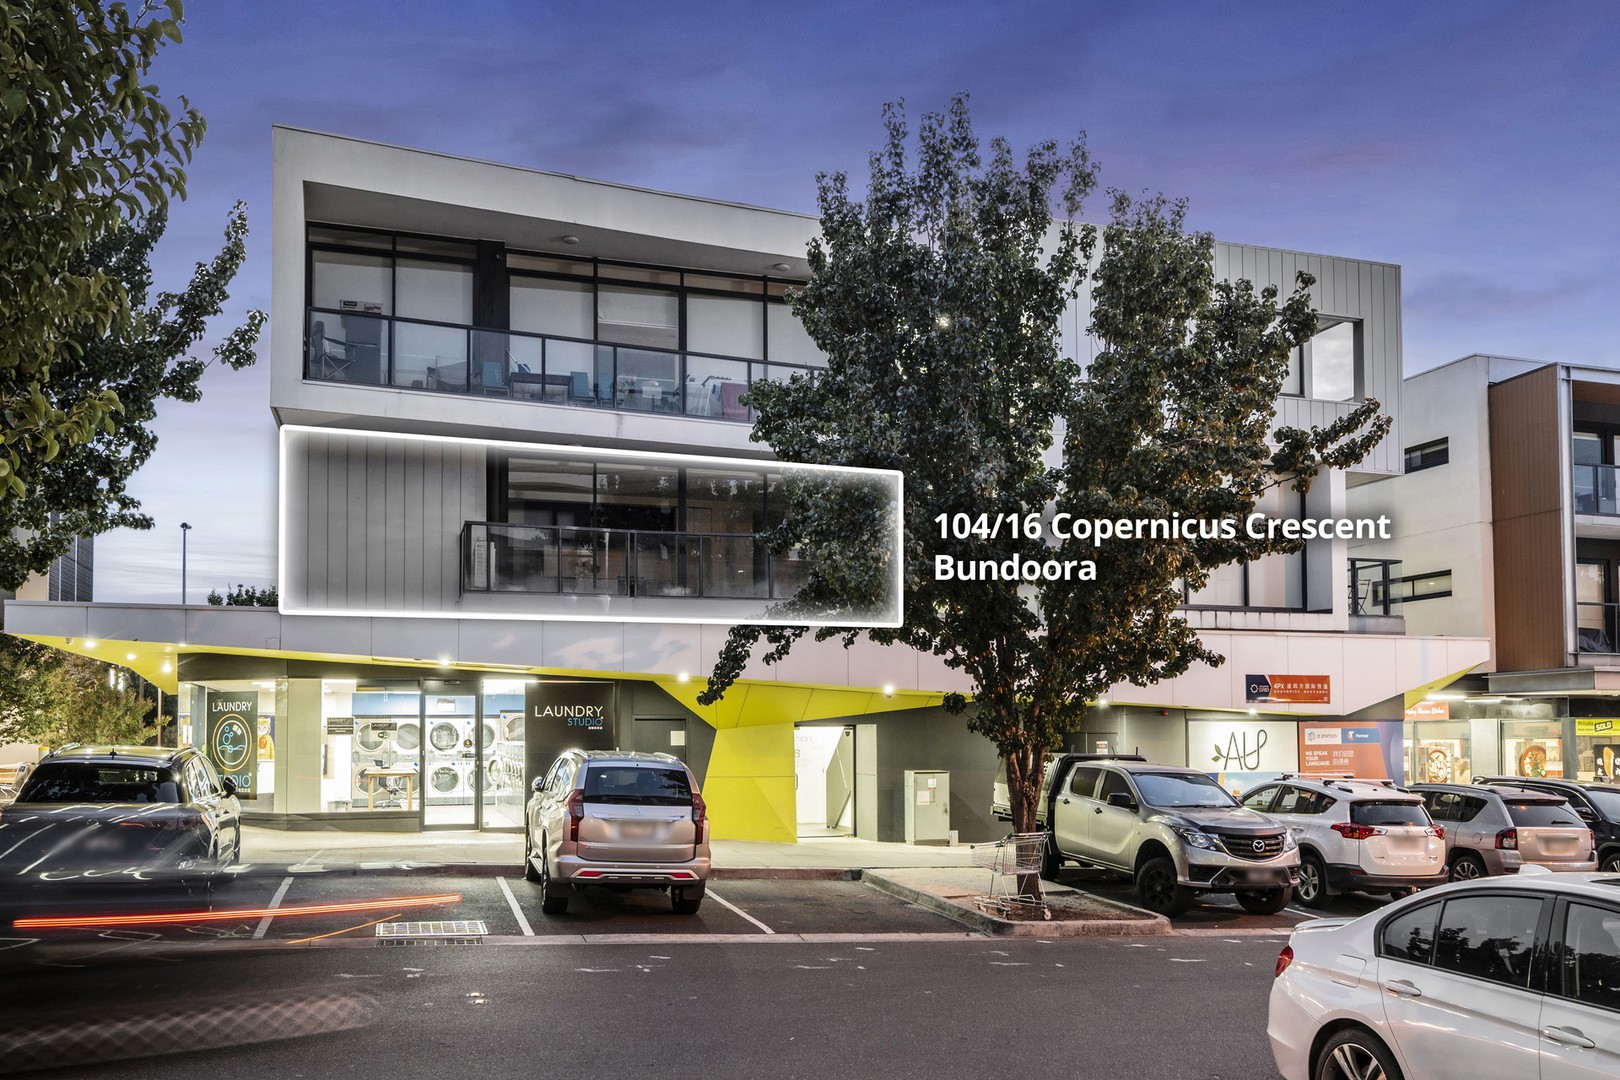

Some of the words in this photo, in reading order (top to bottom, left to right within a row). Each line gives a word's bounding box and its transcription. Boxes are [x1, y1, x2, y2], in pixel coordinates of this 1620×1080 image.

[212, 701, 253, 712] LAUNDRY
[534, 705, 604, 717] LAUNDRY
[567, 717, 604, 726] STUDIO
[1595, 721, 1612, 731] SOLD
